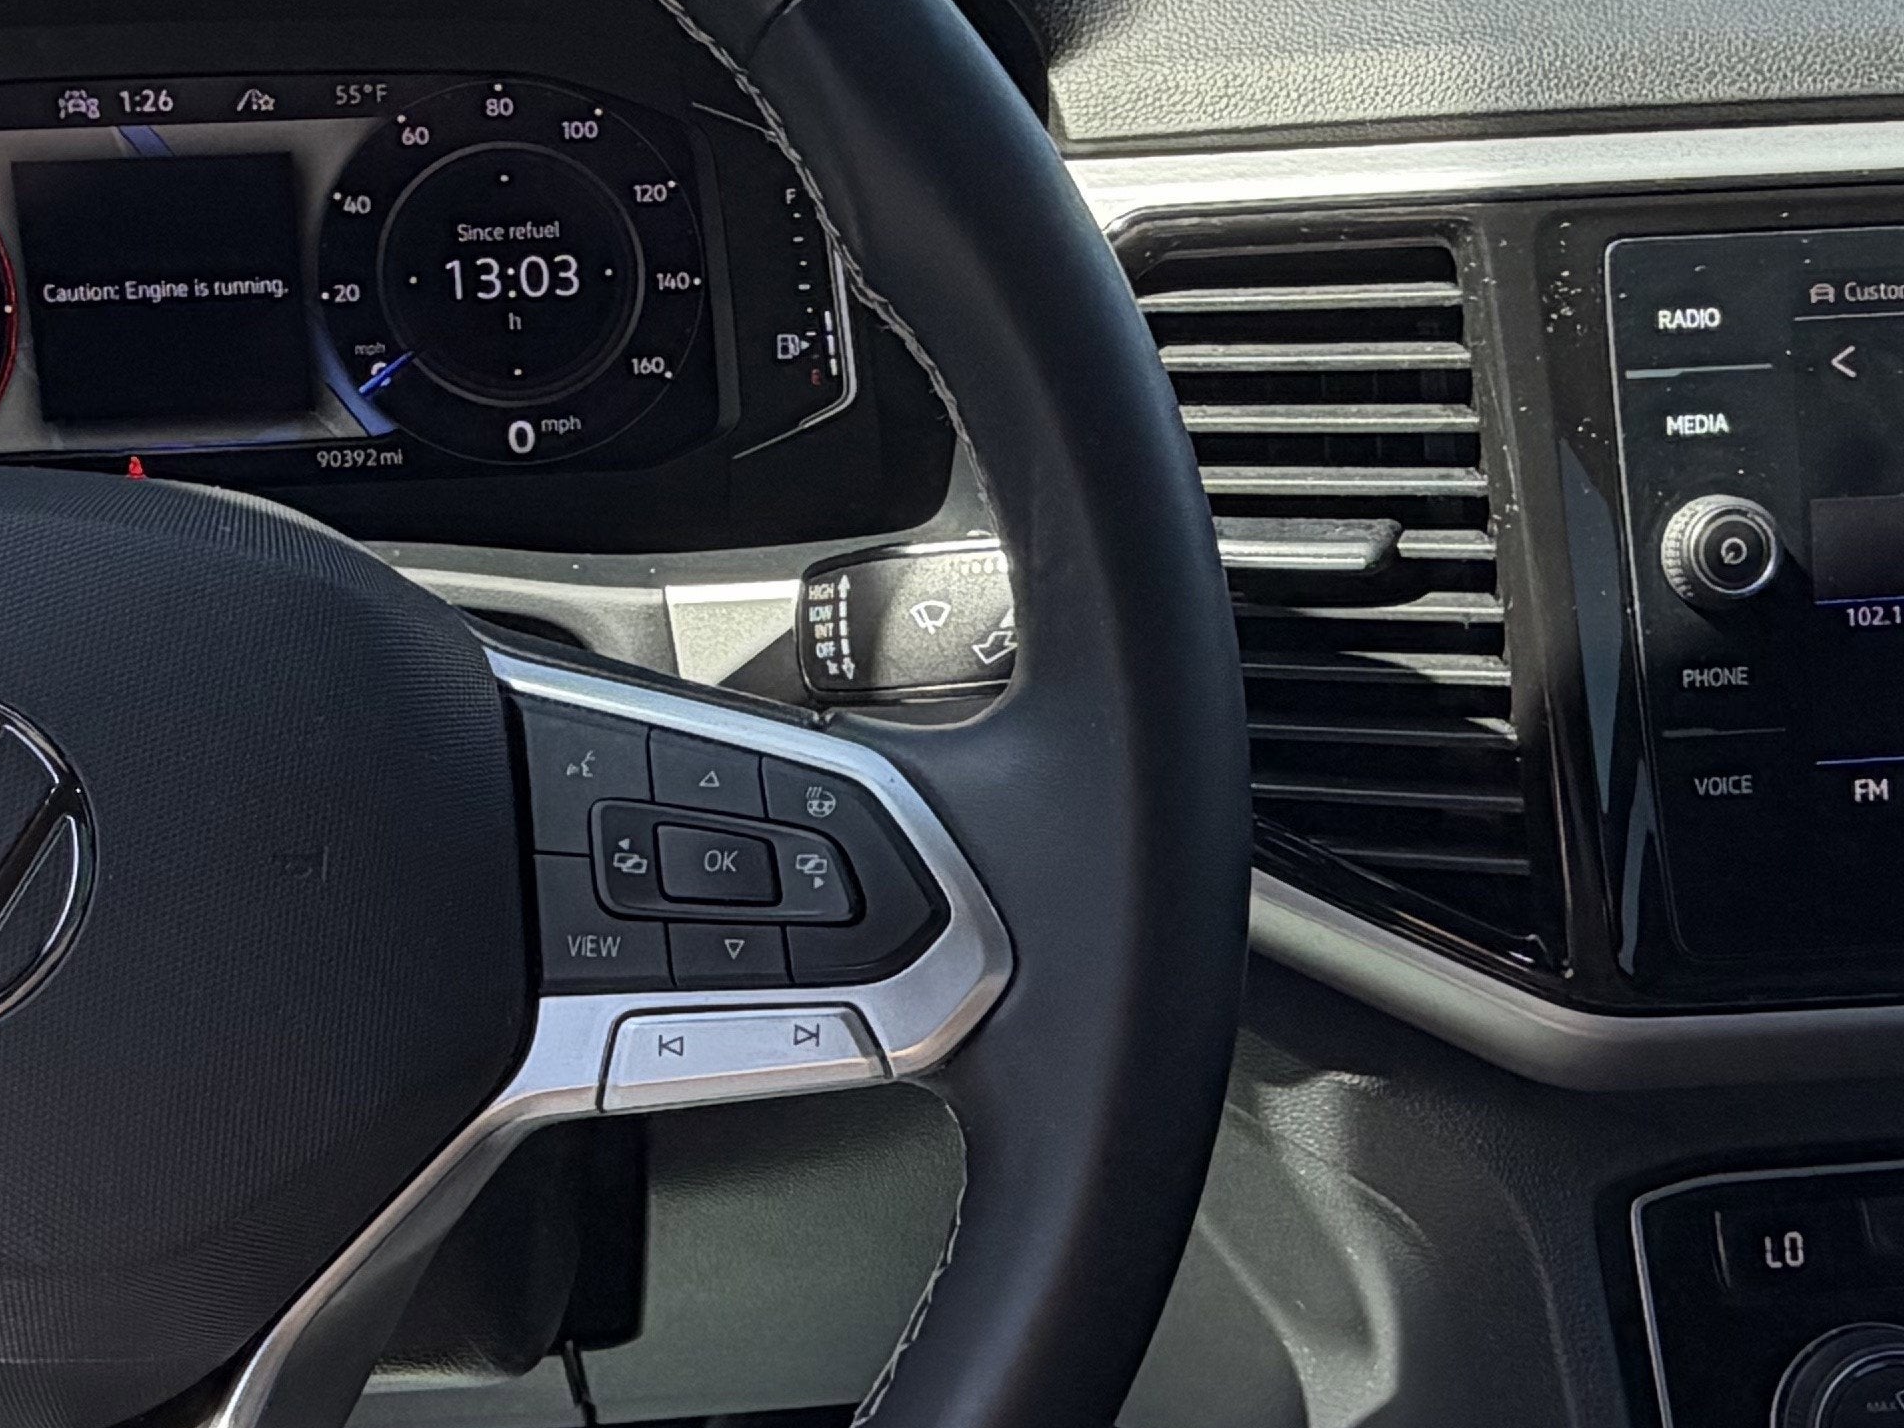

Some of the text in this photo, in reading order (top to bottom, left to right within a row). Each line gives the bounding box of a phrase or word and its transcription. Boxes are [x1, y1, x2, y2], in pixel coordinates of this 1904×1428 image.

[119, 89, 174, 114] 1:26
[485, 97, 514, 118] 80
[401, 126, 430, 146] 60
[562, 120, 598, 141] 100
[342, 194, 371, 215] 40
[633, 184, 668, 204] 120
[785, 188, 798, 205] F
[456, 220, 561, 242] Since refuel
[445, 254, 580, 301] 13:03
[656, 272, 689, 291] 140
[43, 276, 290, 303] Caution: Engine is running.
[333, 283, 361, 304] 20
[508, 313, 522, 331] h
[1657, 307, 1723, 332] RADIO
[631, 356, 665, 376] 160
[508, 415, 582, 454] 0 mph
[1666, 413, 1730, 437] MEDIA
[1847, 606, 1903, 627] 102.1
[1682, 666, 1750, 689] PHONE
[1693, 774, 1754, 797] VOICE
[1853, 778, 1890, 803] FM
[703, 850, 738, 875] OK
[566, 935, 622, 959] VIEW
[1763, 1230, 1805, 1269] LO
